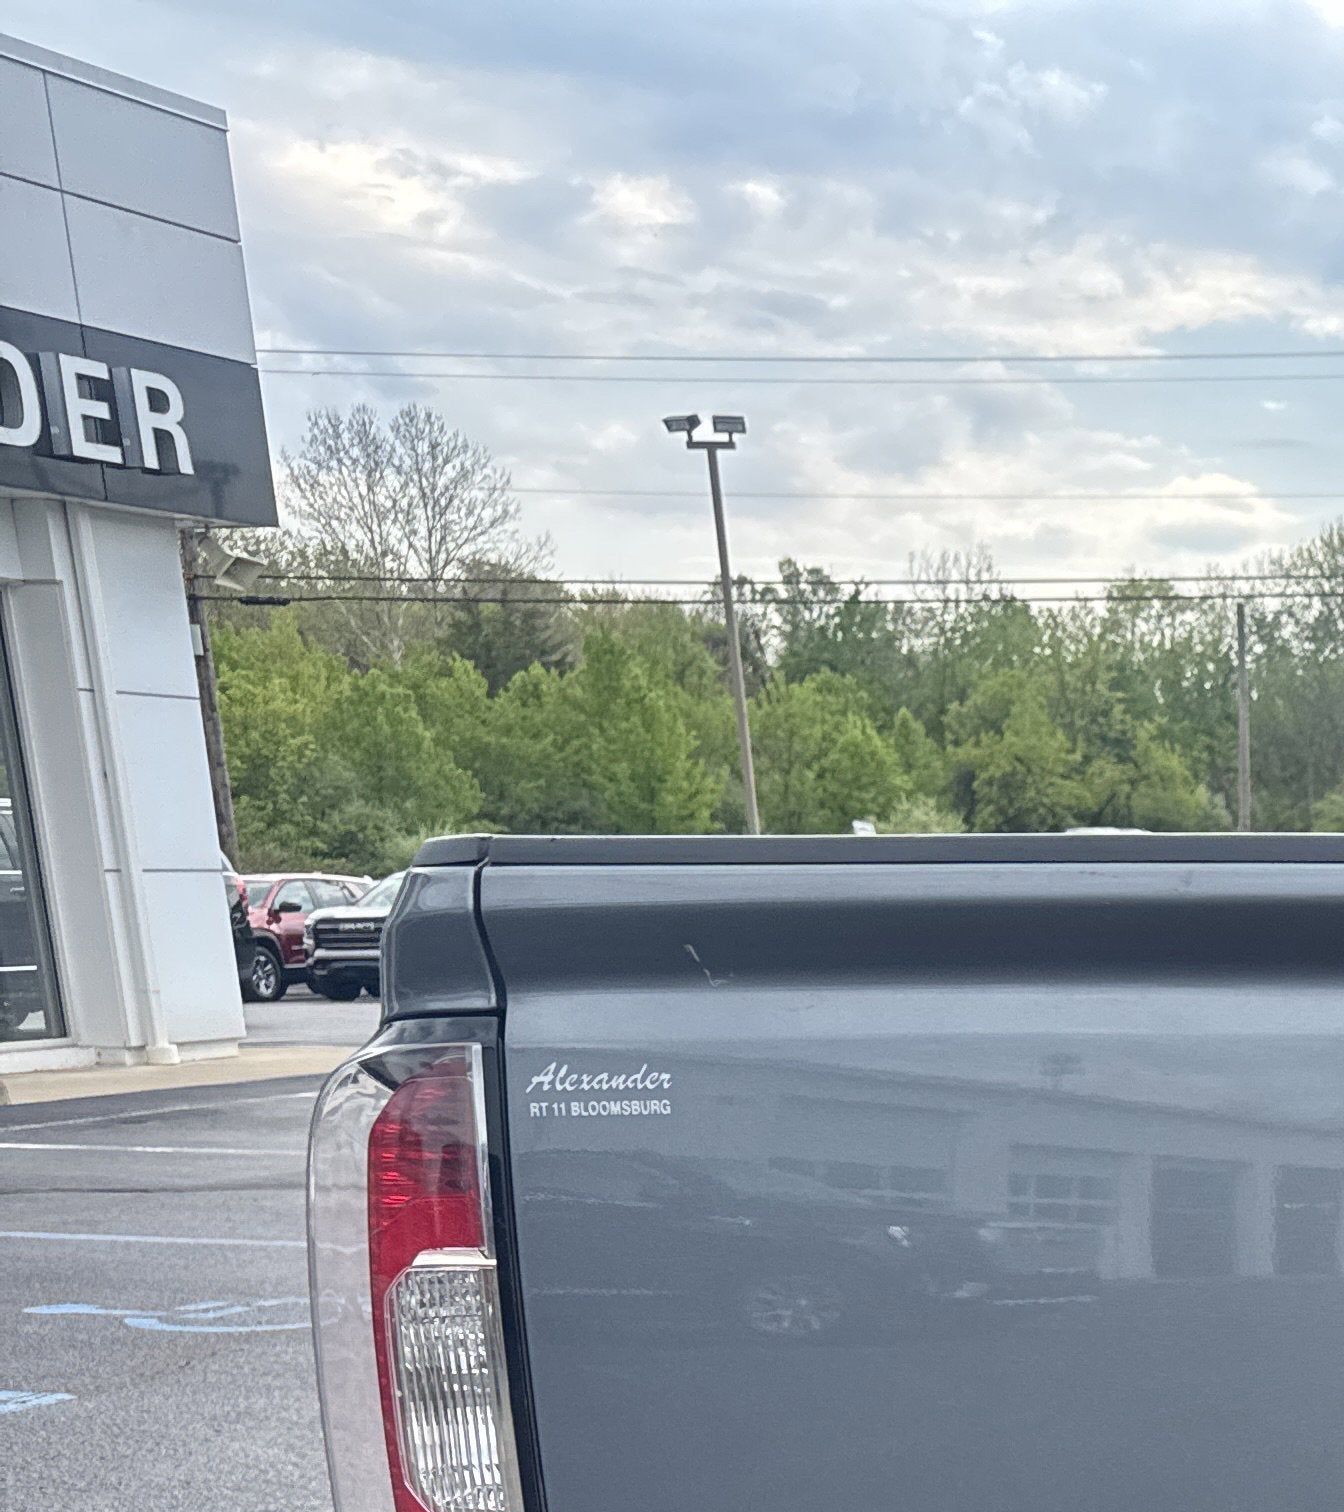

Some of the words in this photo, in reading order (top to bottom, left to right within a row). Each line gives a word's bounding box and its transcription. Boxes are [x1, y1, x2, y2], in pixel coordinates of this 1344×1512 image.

[525, 1062, 673, 1094] Alexander
[530, 1102, 549, 1117] RT
[552, 1102, 566, 1117] 11
[571, 1099, 672, 1117] BLOOMSBURG
